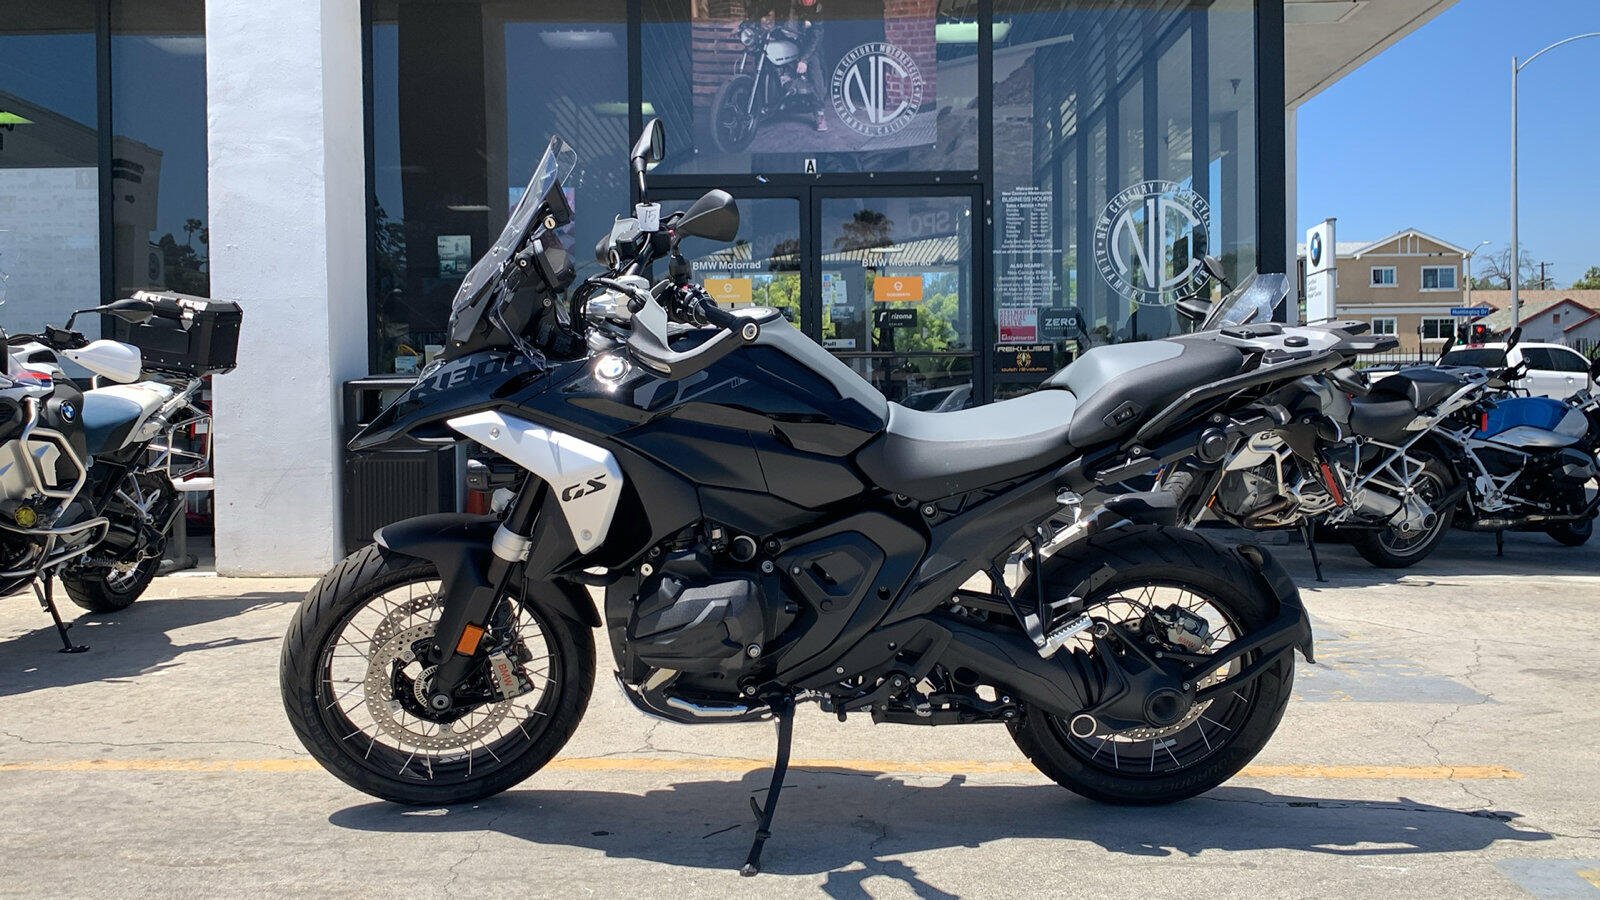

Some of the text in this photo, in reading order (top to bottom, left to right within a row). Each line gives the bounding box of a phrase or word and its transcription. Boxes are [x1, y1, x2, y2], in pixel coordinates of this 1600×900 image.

[834, 44, 920, 86] NEW CENTURY MOTORCYCLES
[806, 160, 816, 173] A
[1097, 215, 1110, 239] NEW
[1109, 183, 1154, 214] CENTURY
[692, 260, 761, 270] BMW Motorrad
[862, 259, 887, 267] BMW
[1045, 317, 1077, 326] ZERO
[561, 474, 607, 502] GS
[497, 663, 514, 686] BMW
